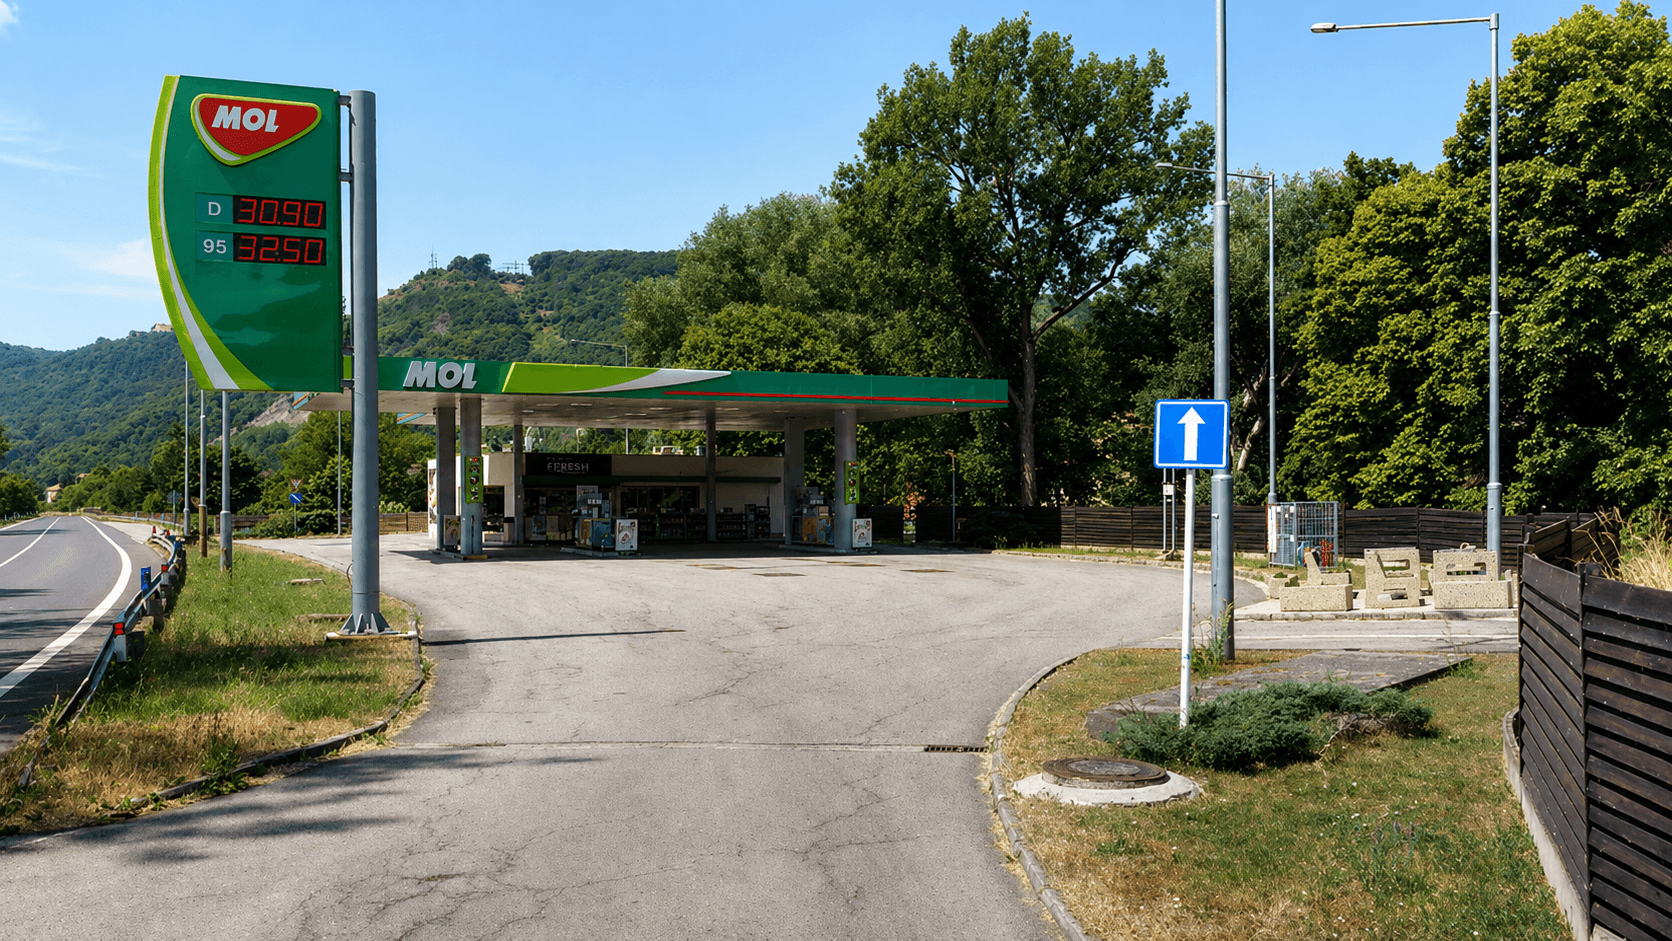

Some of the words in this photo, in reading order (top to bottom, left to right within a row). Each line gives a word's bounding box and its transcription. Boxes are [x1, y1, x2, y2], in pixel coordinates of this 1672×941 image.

[211, 105, 279, 133] MOL
[207, 202, 221, 216] D
[238, 198, 323, 228] 30.90
[203, 239, 227, 255] 95
[238, 235, 323, 264] 32.50
[403, 360, 478, 390] MOL
